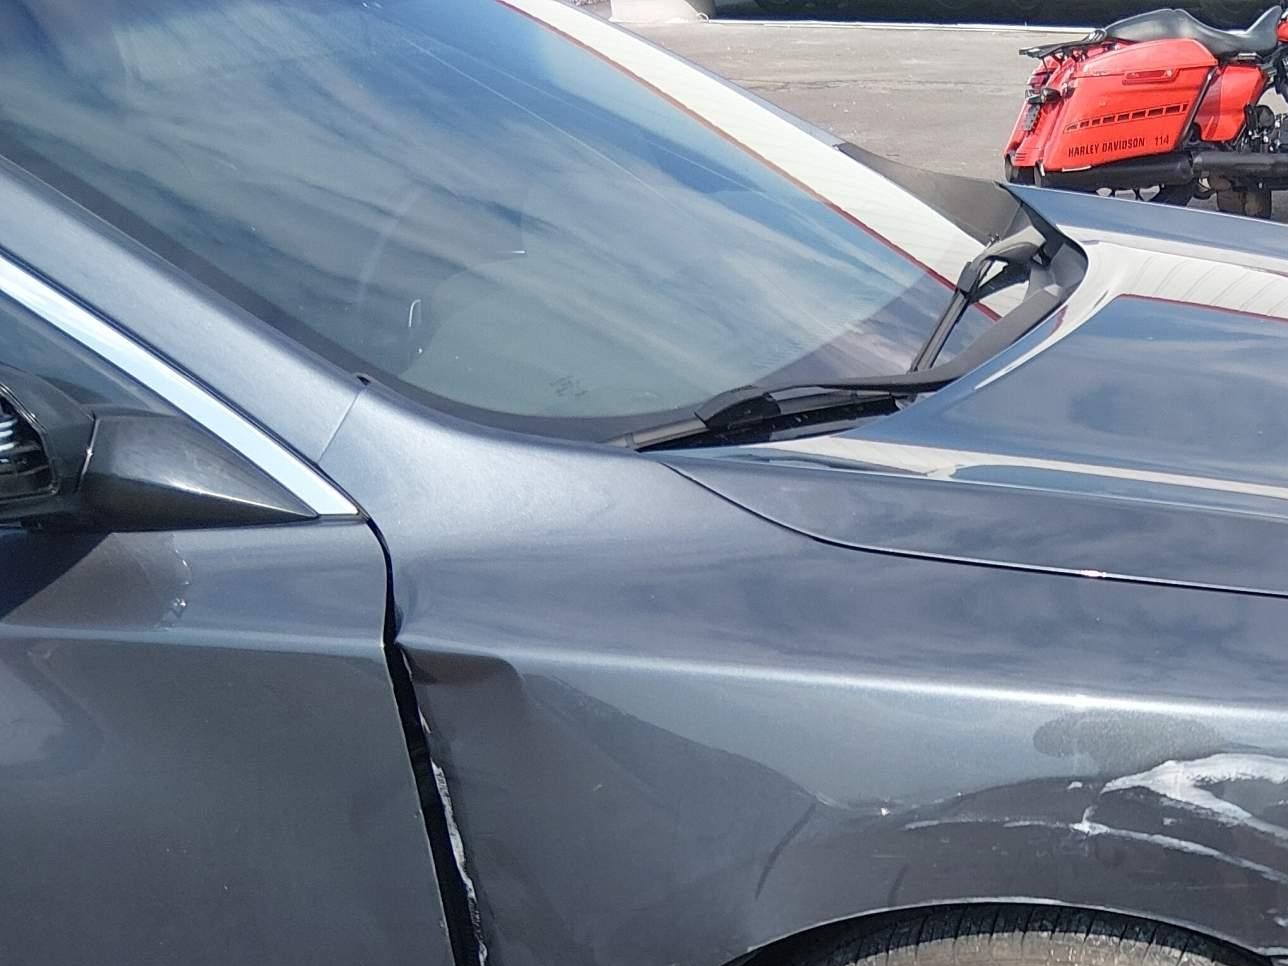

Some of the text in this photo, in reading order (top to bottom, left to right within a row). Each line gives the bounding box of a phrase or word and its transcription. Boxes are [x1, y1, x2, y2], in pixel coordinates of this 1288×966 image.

[1068, 135, 1169, 158] HARLEY DAVIDSON 114
